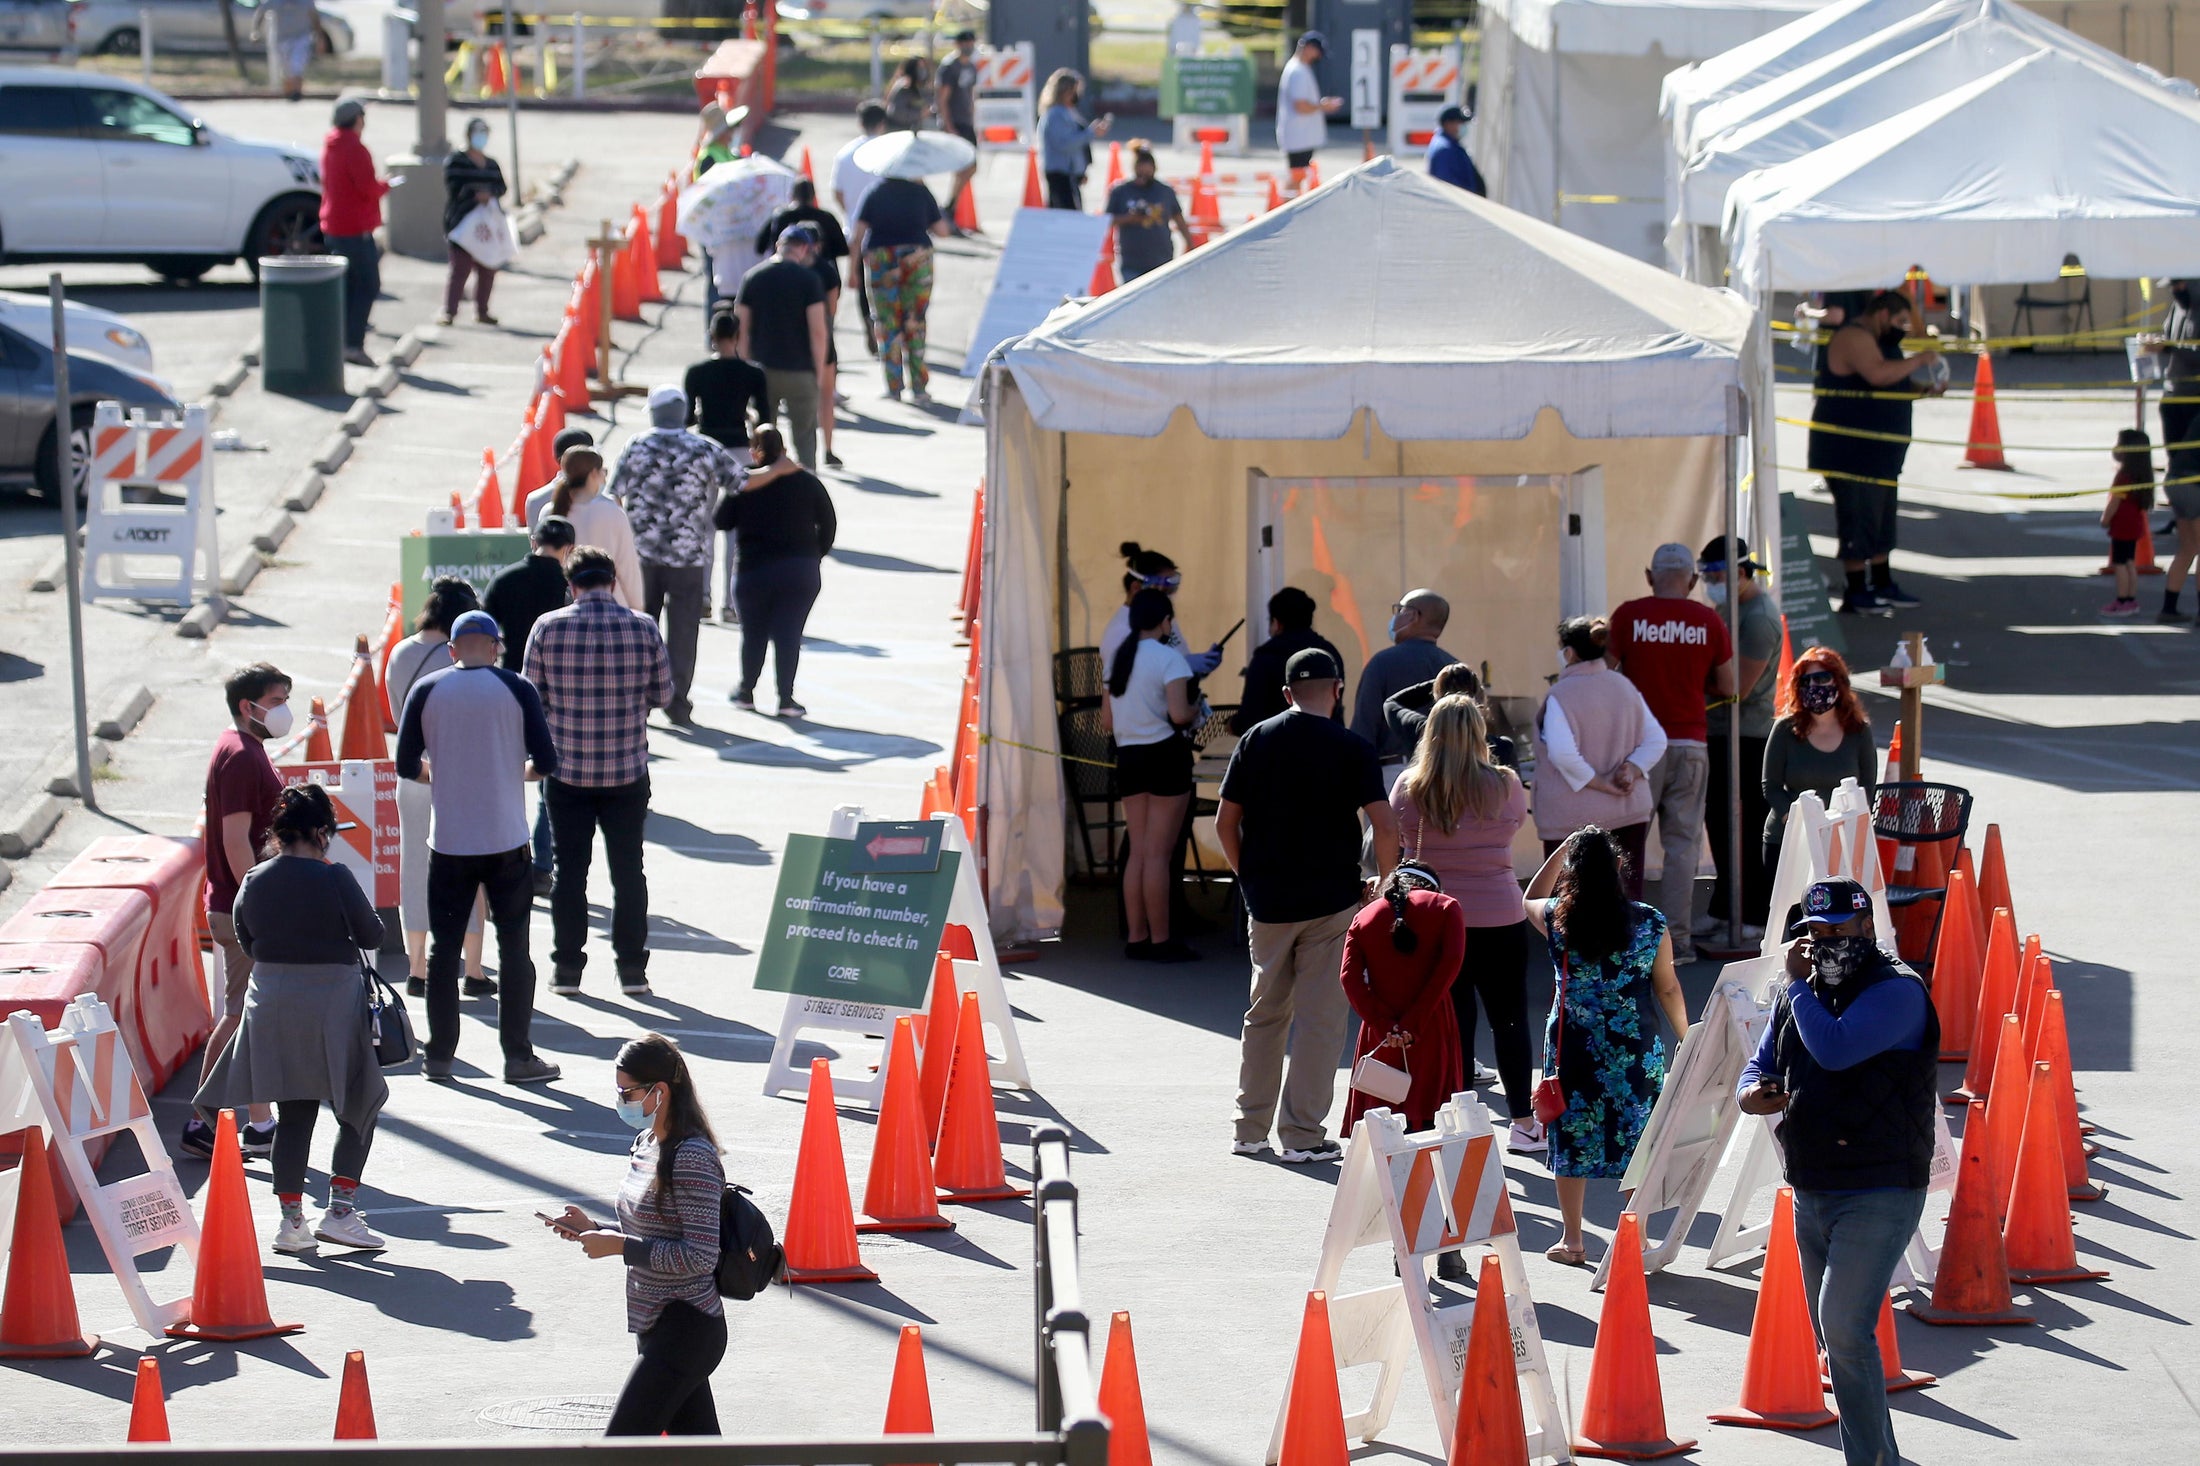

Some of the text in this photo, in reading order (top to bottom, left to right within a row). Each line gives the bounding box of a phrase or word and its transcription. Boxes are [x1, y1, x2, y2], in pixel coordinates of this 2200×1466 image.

[1633, 618, 1707, 646] MedMen
[822, 870, 908, 895] If you have a
[785, 896, 930, 927] confirmation number,
[785, 923, 919, 950] proceed to check in
[827, 965, 861, 981] CORE
[804, 999, 838, 1015] STREET
[840, 1004, 886, 1021] SERVICES
[139, 1203, 158, 1217] PUBLIC
[156, 1198, 175, 1212] WORKS
[125, 1210, 181, 1237] STREET SERVICES
